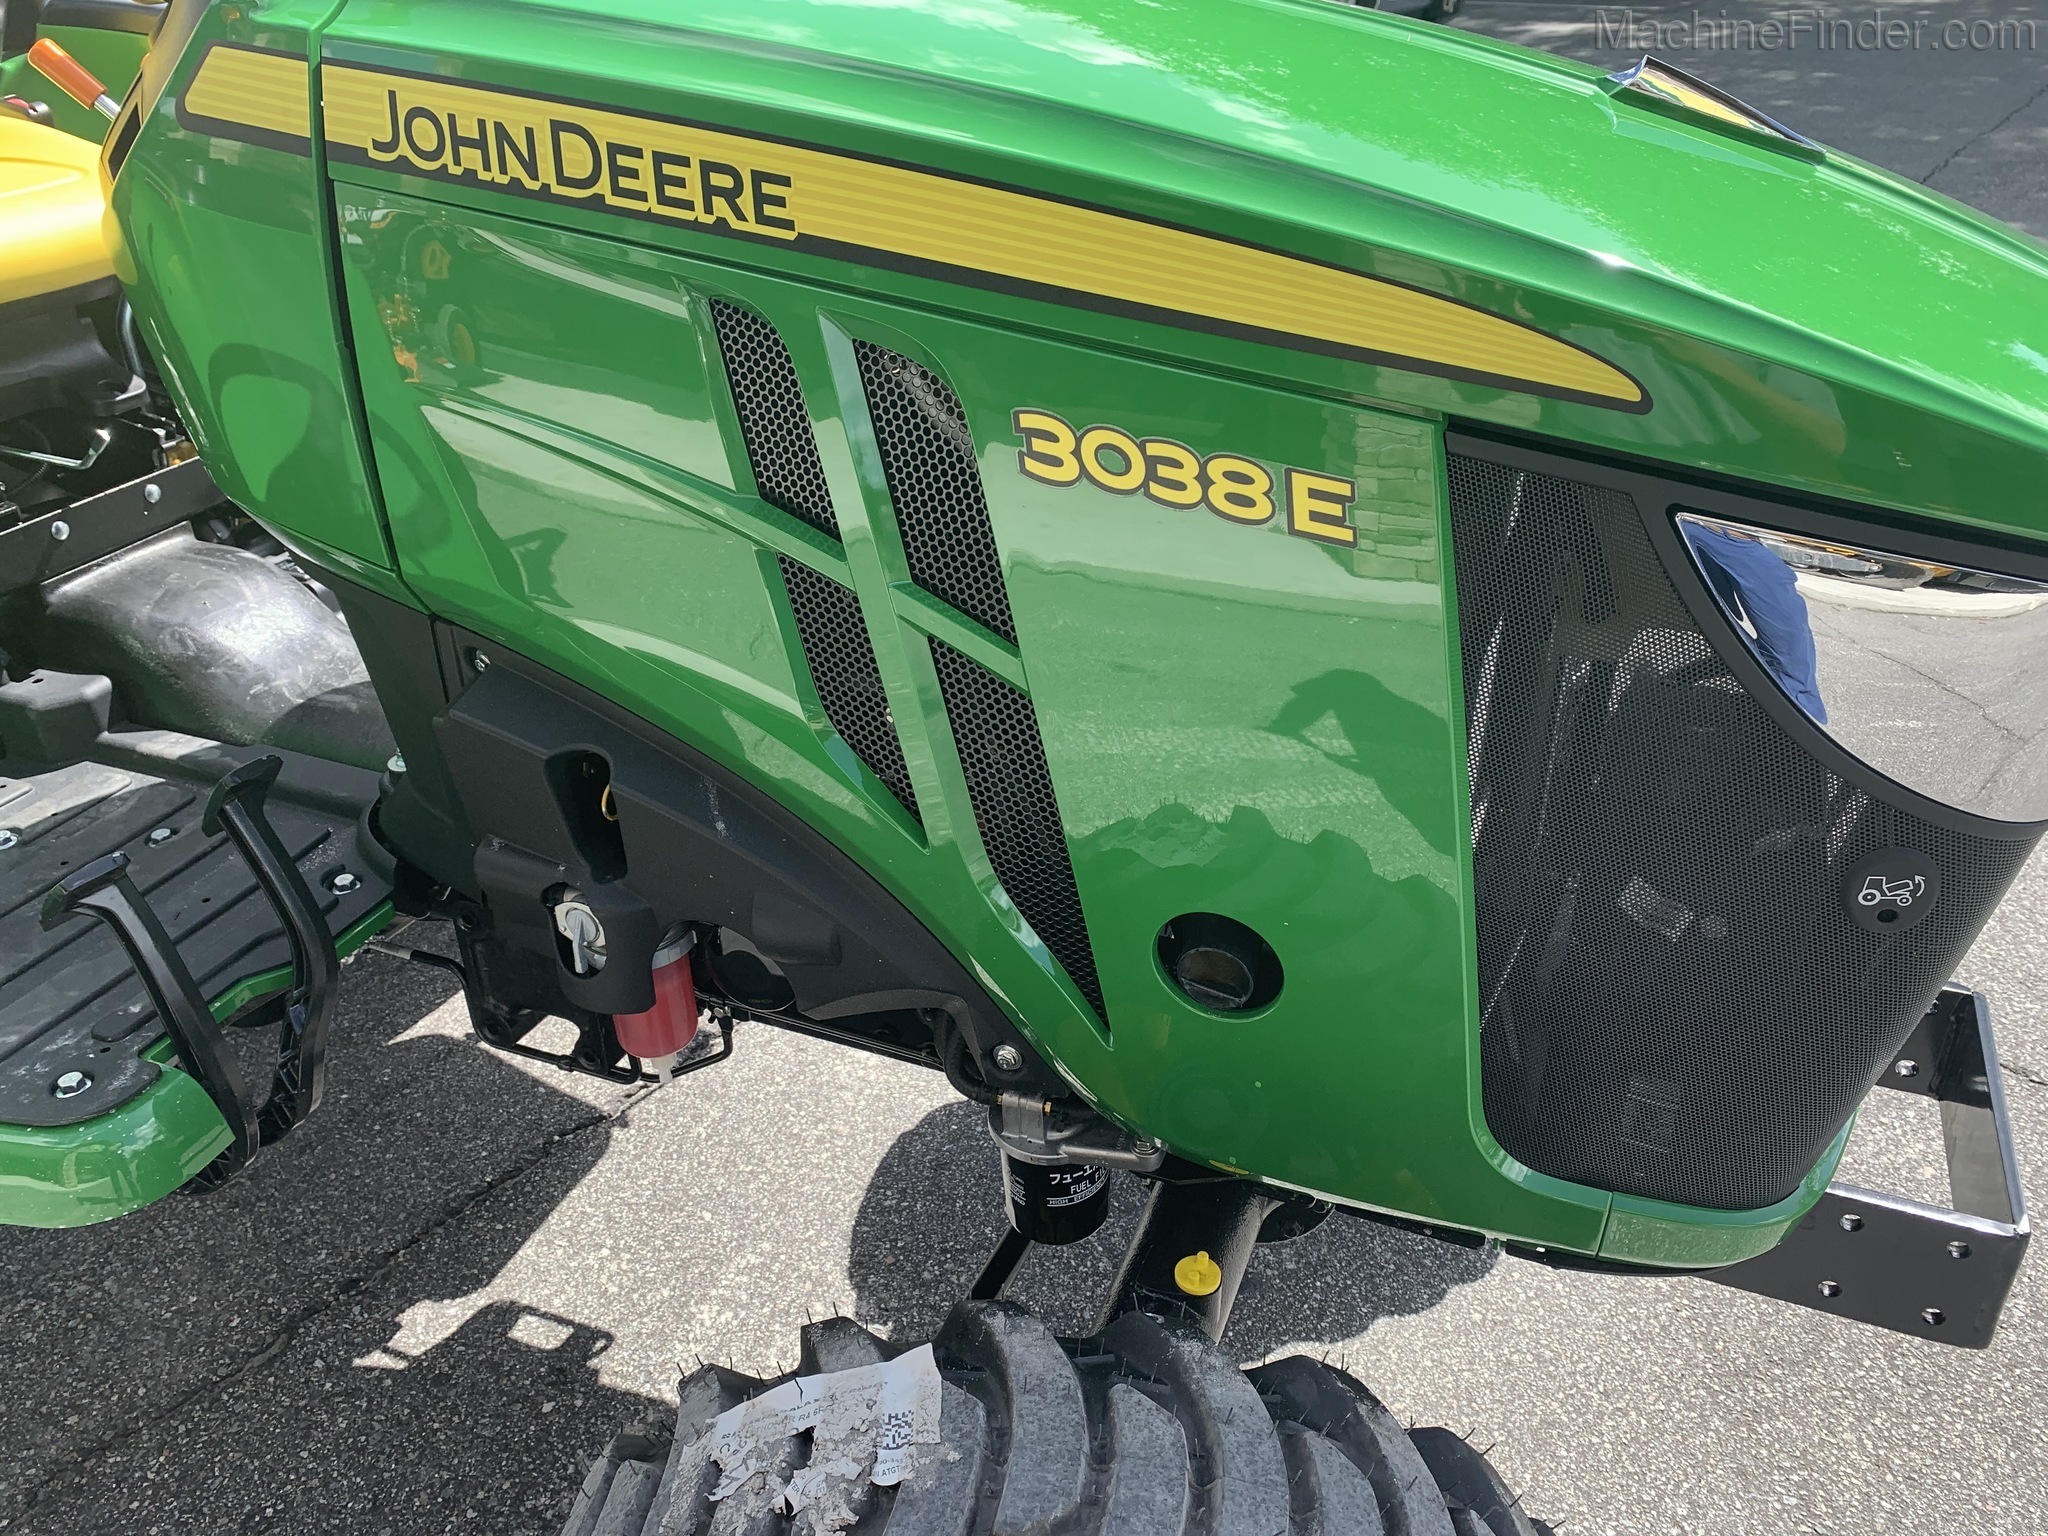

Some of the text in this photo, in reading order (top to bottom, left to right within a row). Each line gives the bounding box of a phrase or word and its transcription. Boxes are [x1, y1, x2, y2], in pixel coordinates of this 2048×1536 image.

[369, 89, 797, 237] JOHN DEERE
[1070, 1179, 1092, 1194] FUEL
